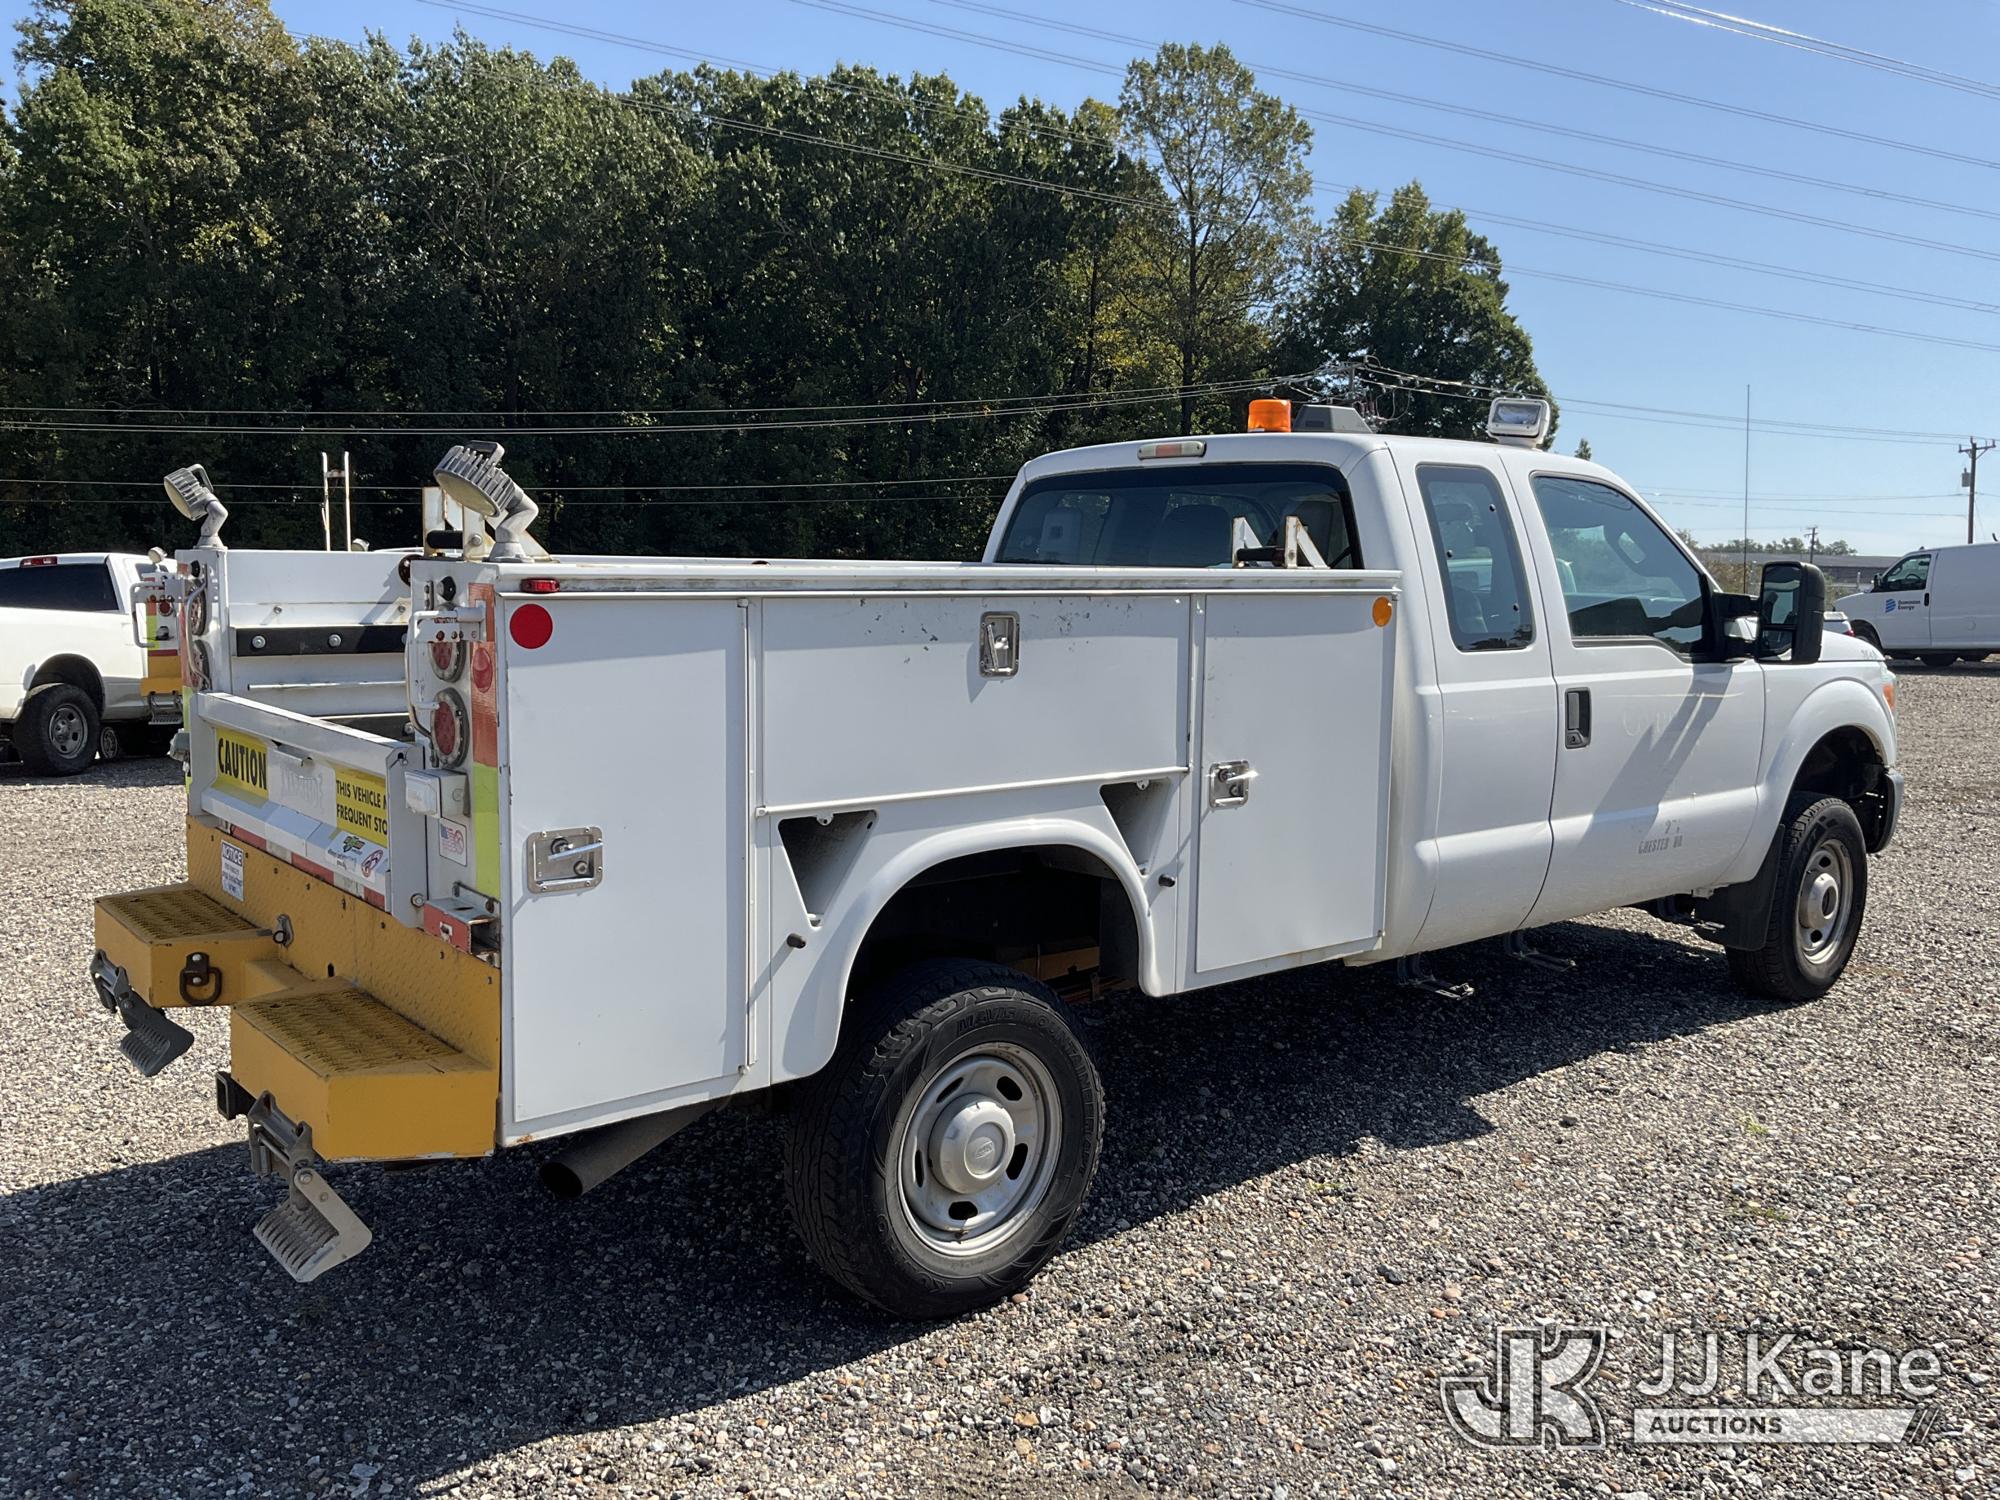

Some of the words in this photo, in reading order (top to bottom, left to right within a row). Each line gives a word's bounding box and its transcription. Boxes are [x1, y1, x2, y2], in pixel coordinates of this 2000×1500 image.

[218, 737, 267, 790] CAUTION
[336, 779, 351, 798] THIS
[352, 784, 381, 809] VEHICLE
[336, 803, 372, 829] FREQUENT
